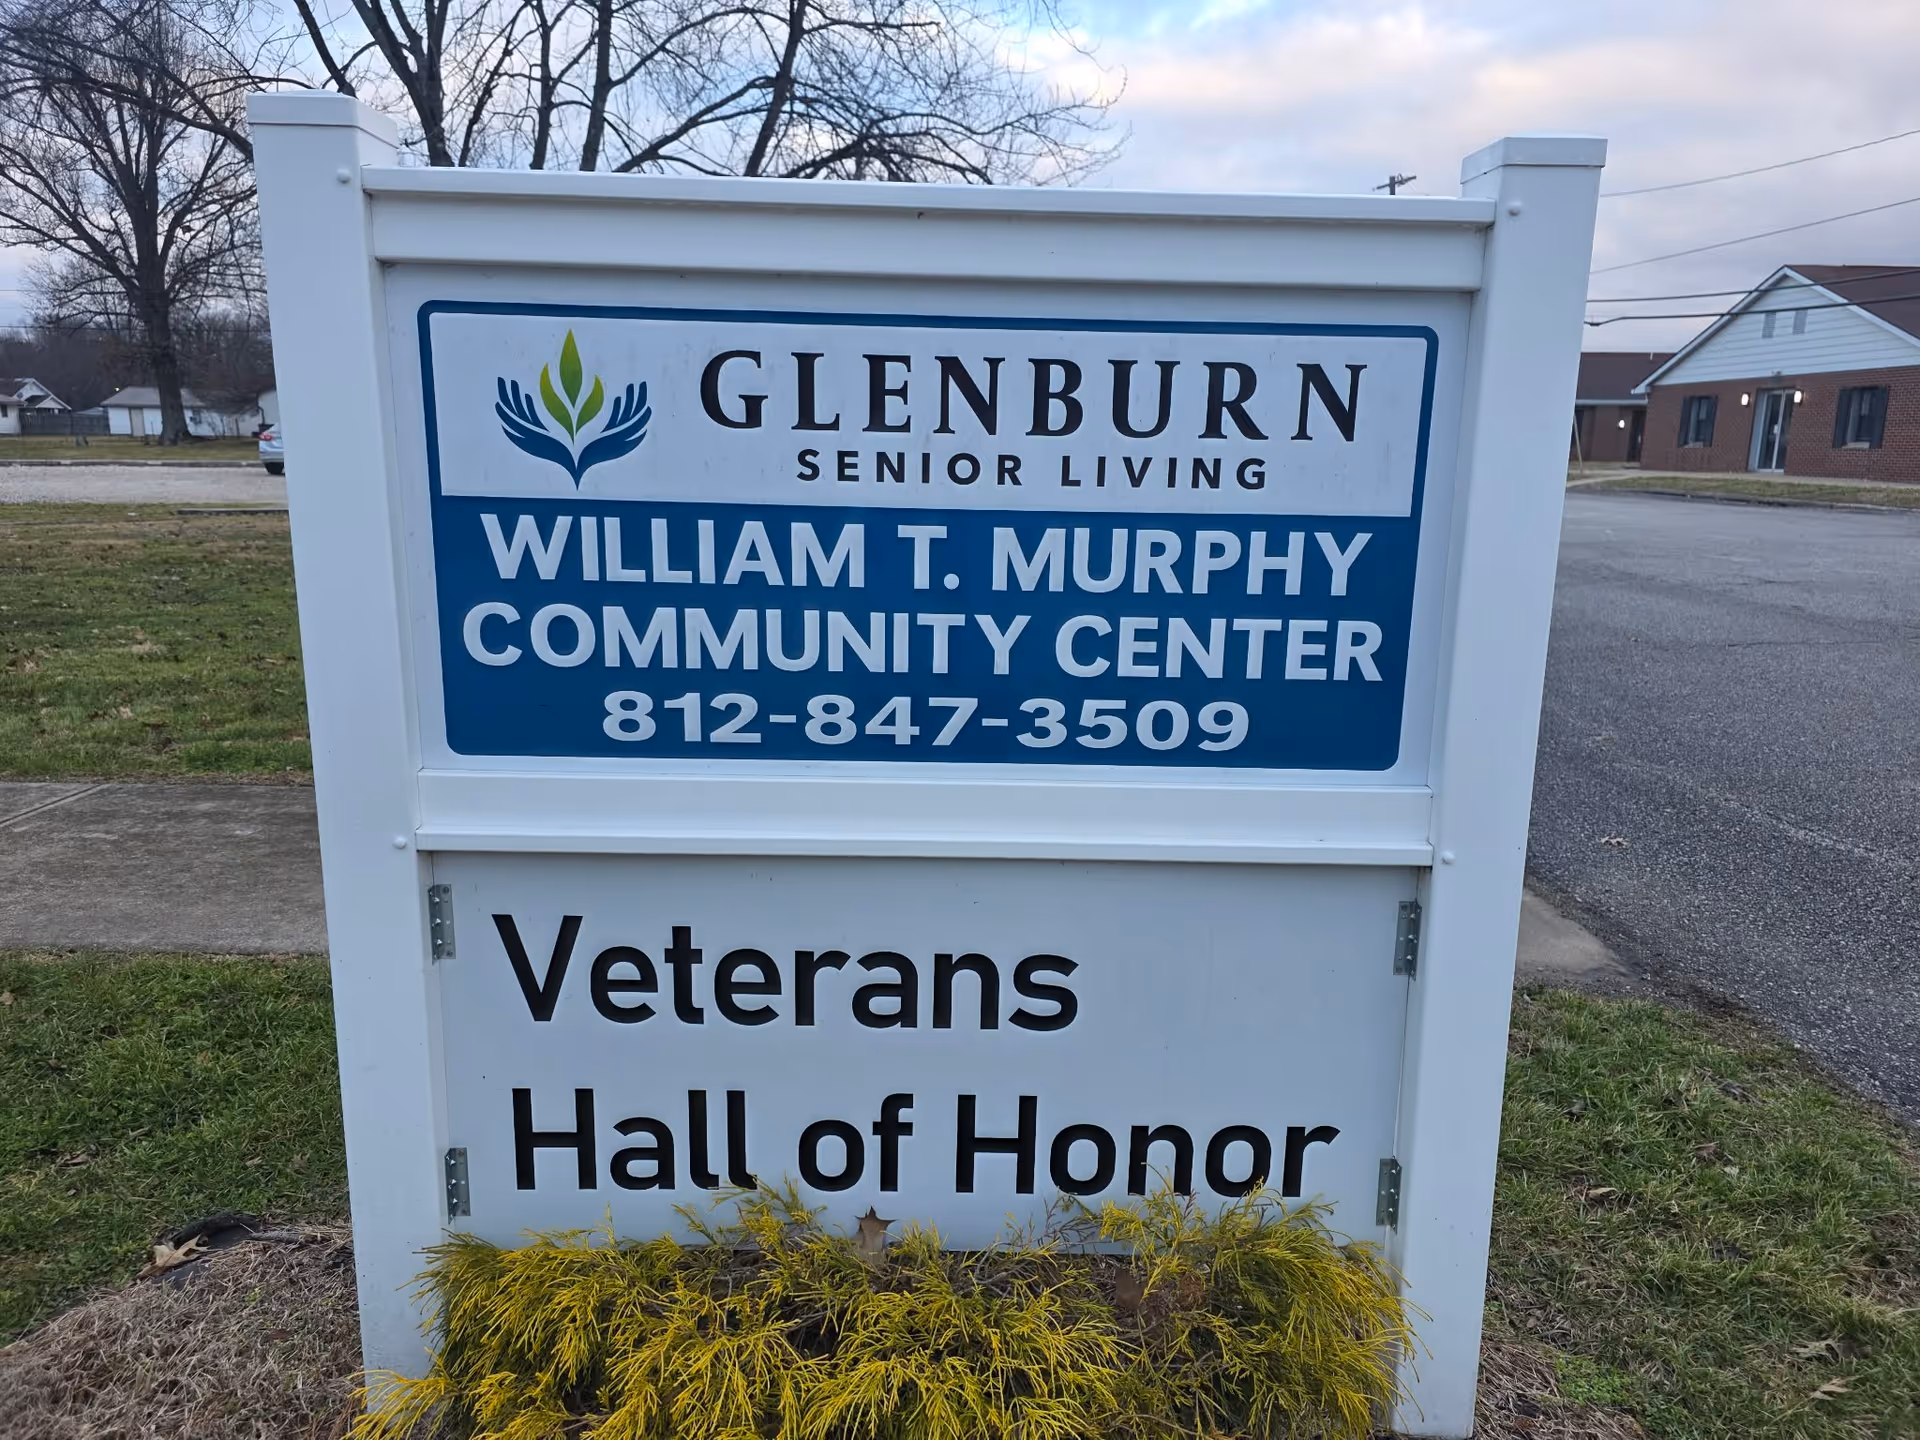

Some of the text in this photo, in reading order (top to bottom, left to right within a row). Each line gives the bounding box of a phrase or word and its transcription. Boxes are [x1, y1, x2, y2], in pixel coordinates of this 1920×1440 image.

[700, 349, 1368, 443] GLENBURN
[796, 448, 1268, 490] SENIOR LIVING
[479, 512, 1373, 598] WILLIAM T. MURPHY
[462, 601, 1384, 684] COMMUNITY CENTER
[601, 690, 1251, 754] 812-847-3509
[491, 913, 1080, 1032] Veterans
[511, 1086, 1341, 1199] Hall of Honor
